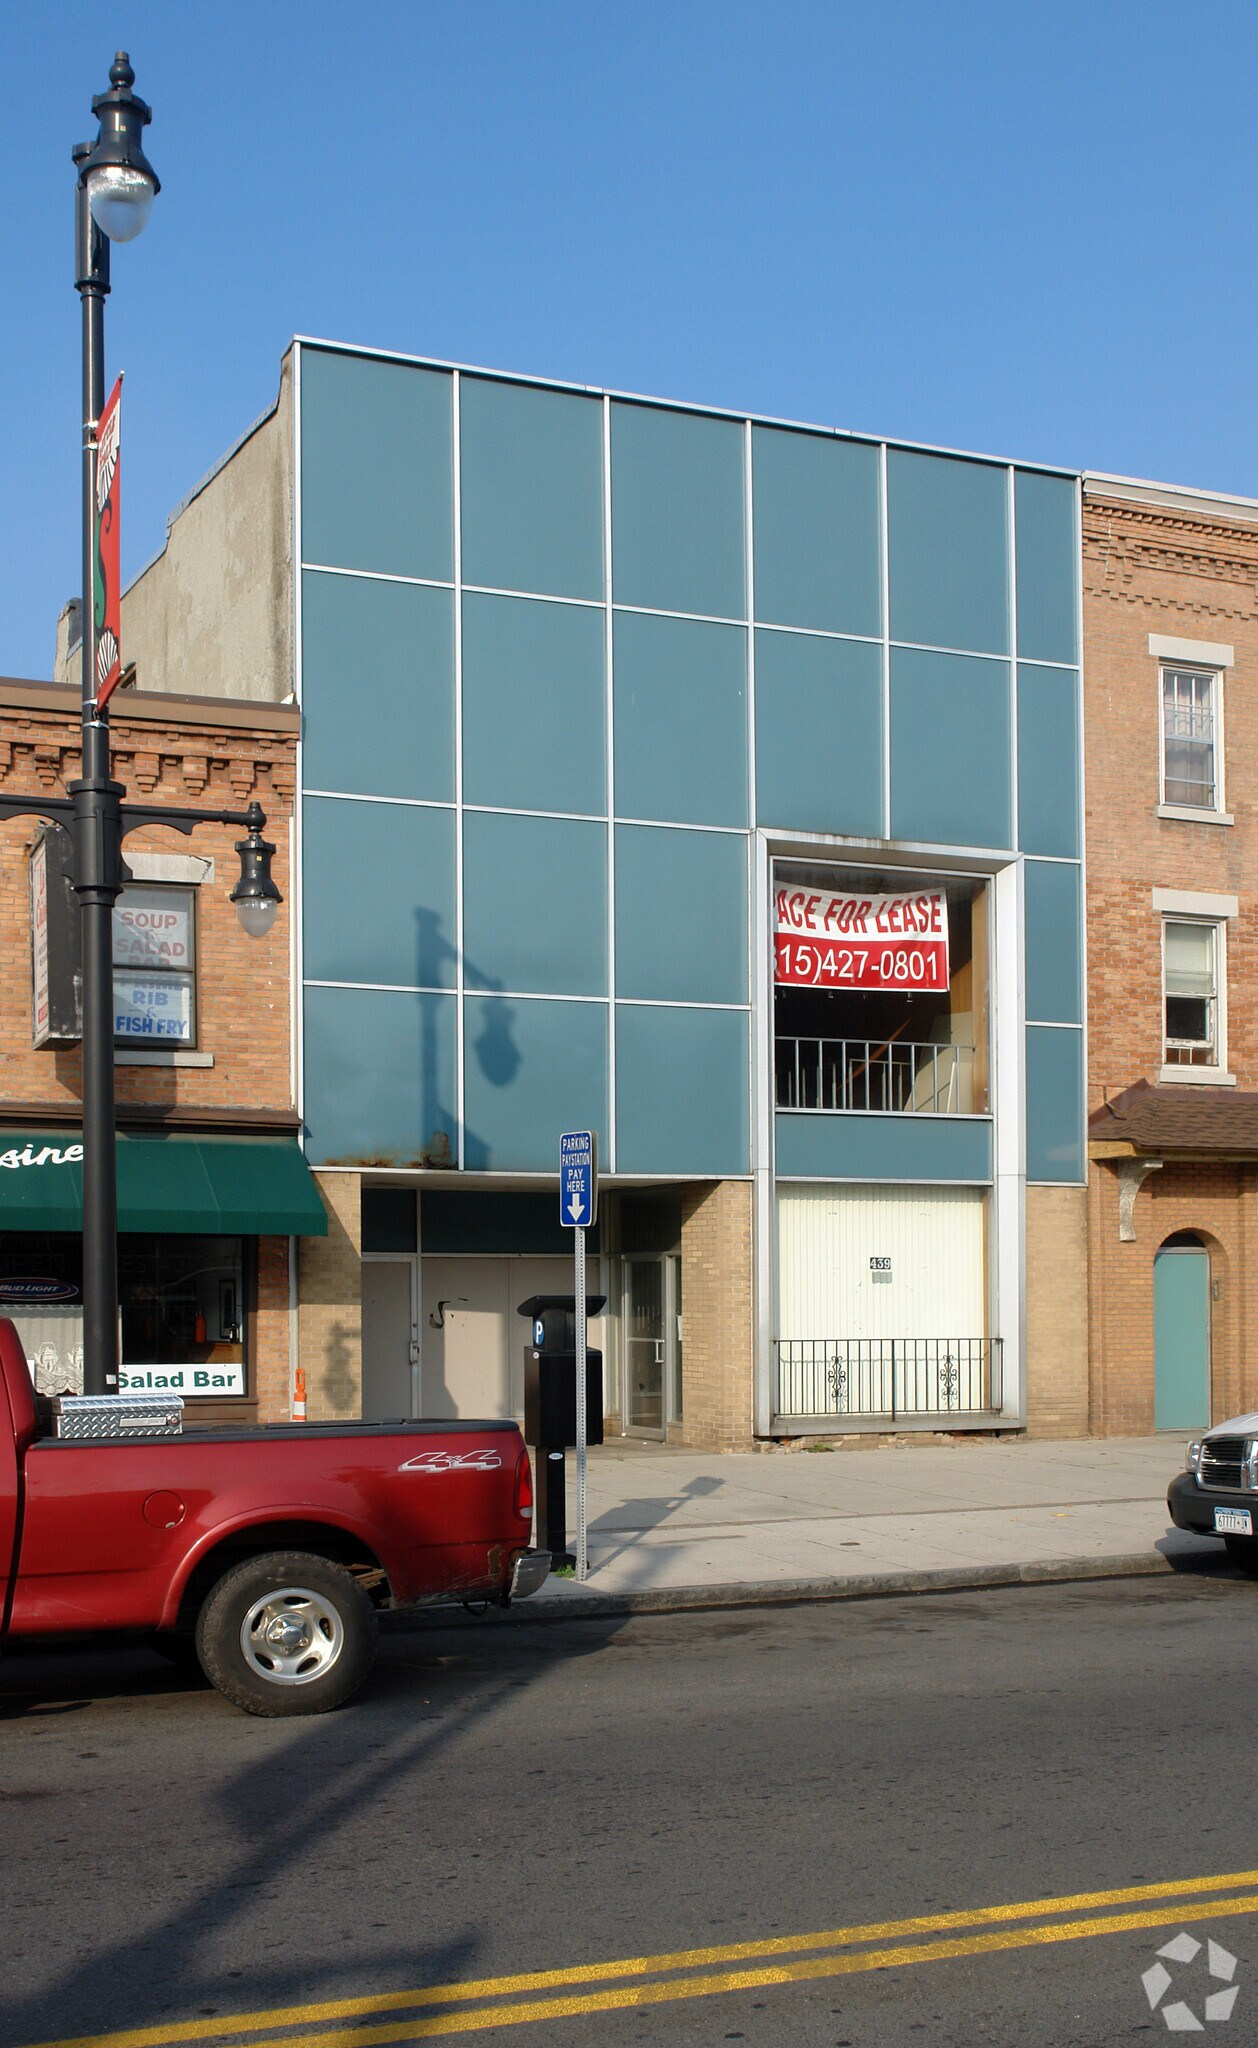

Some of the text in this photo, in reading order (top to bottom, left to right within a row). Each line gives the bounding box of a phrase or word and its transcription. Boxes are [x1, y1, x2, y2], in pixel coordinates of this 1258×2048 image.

[773, 888, 942, 934] ACE FOR LEASE
[120, 911, 178, 930] SOUP
[116, 938, 186, 957] SALAD
[773, 943, 938, 985] 15)427-0801
[132, 990, 169, 1006] RIB
[115, 1016, 188, 1035] FISH FRY
[562, 1136, 589, 1152] PARKING
[568, 1168, 584, 1181] PAY
[566, 1180, 586, 1193] HERE
[870, 1258, 890, 1269] 439
[118, 1371, 237, 1389] Salad Bar
